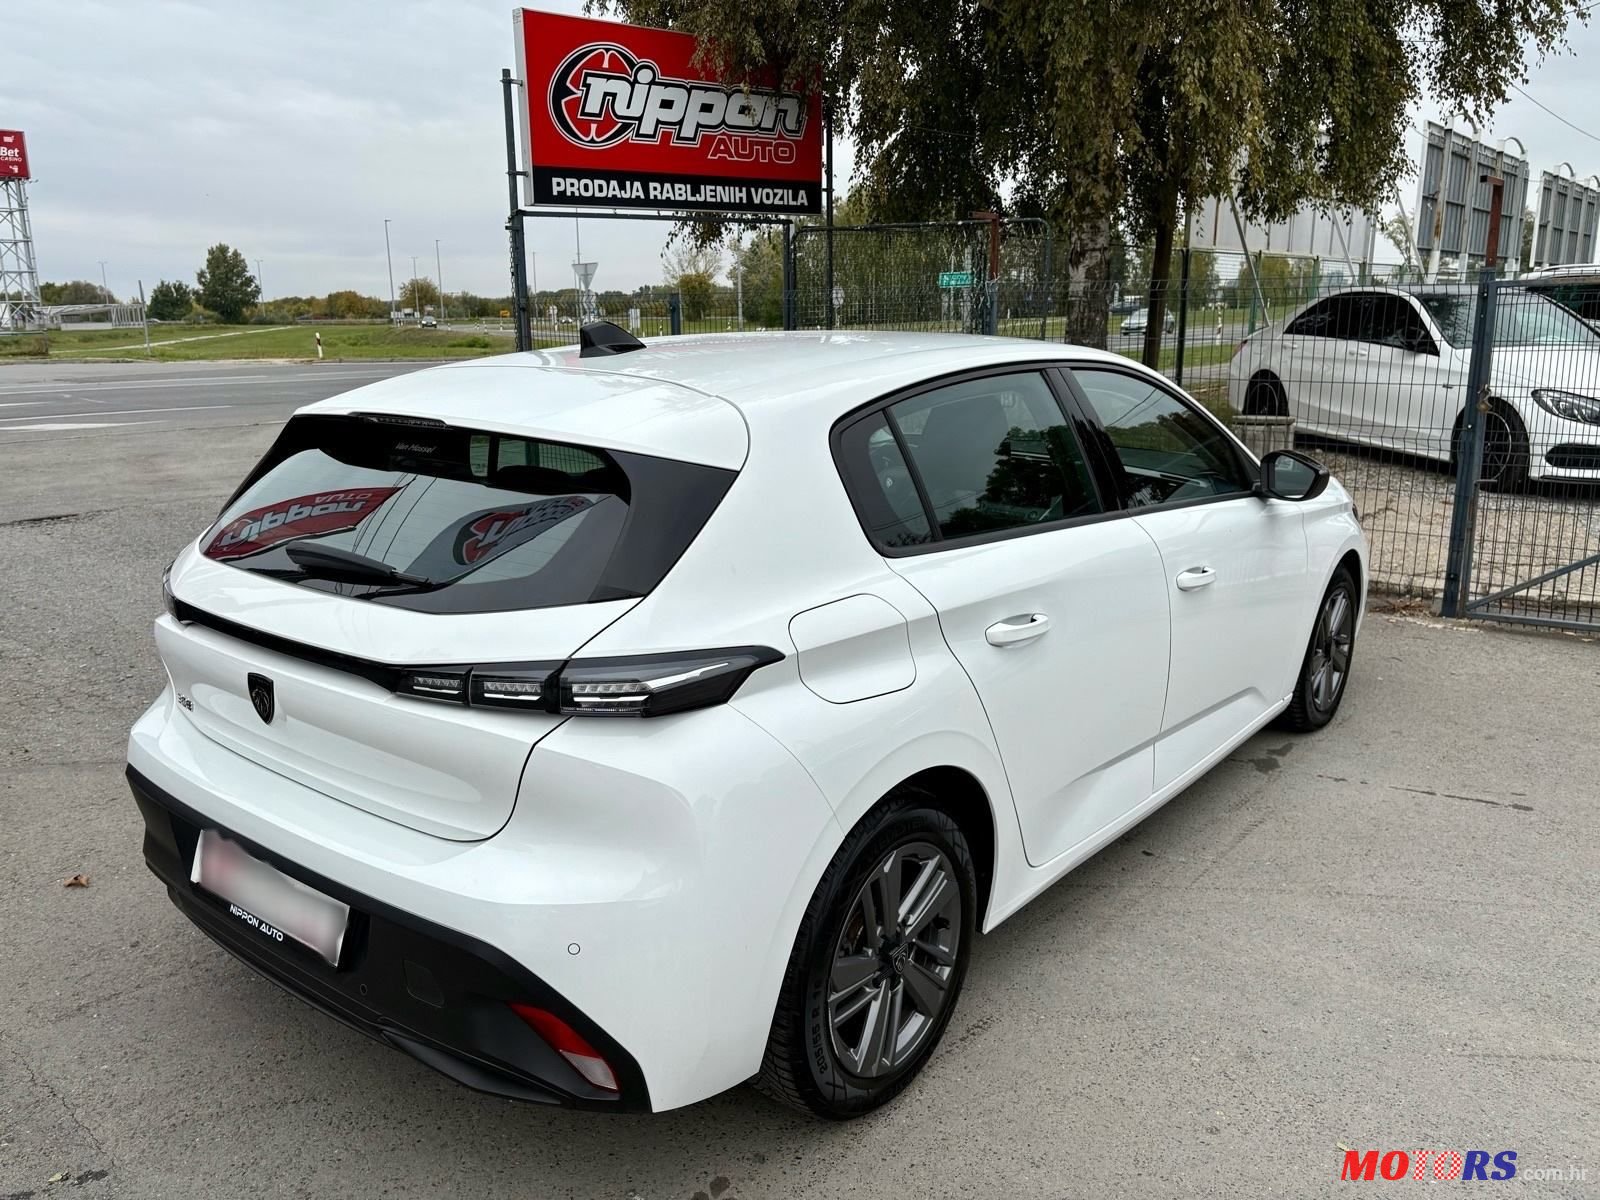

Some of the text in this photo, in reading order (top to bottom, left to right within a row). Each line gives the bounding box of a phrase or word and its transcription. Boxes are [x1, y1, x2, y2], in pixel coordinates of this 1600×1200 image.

[583, 66, 804, 139] nippon
[707, 135, 796, 164] AUTO
[552, 177, 809, 206] PRODAJA RABLJENIH VOZILA
[229, 903, 284, 942] NIPPON AUTO
